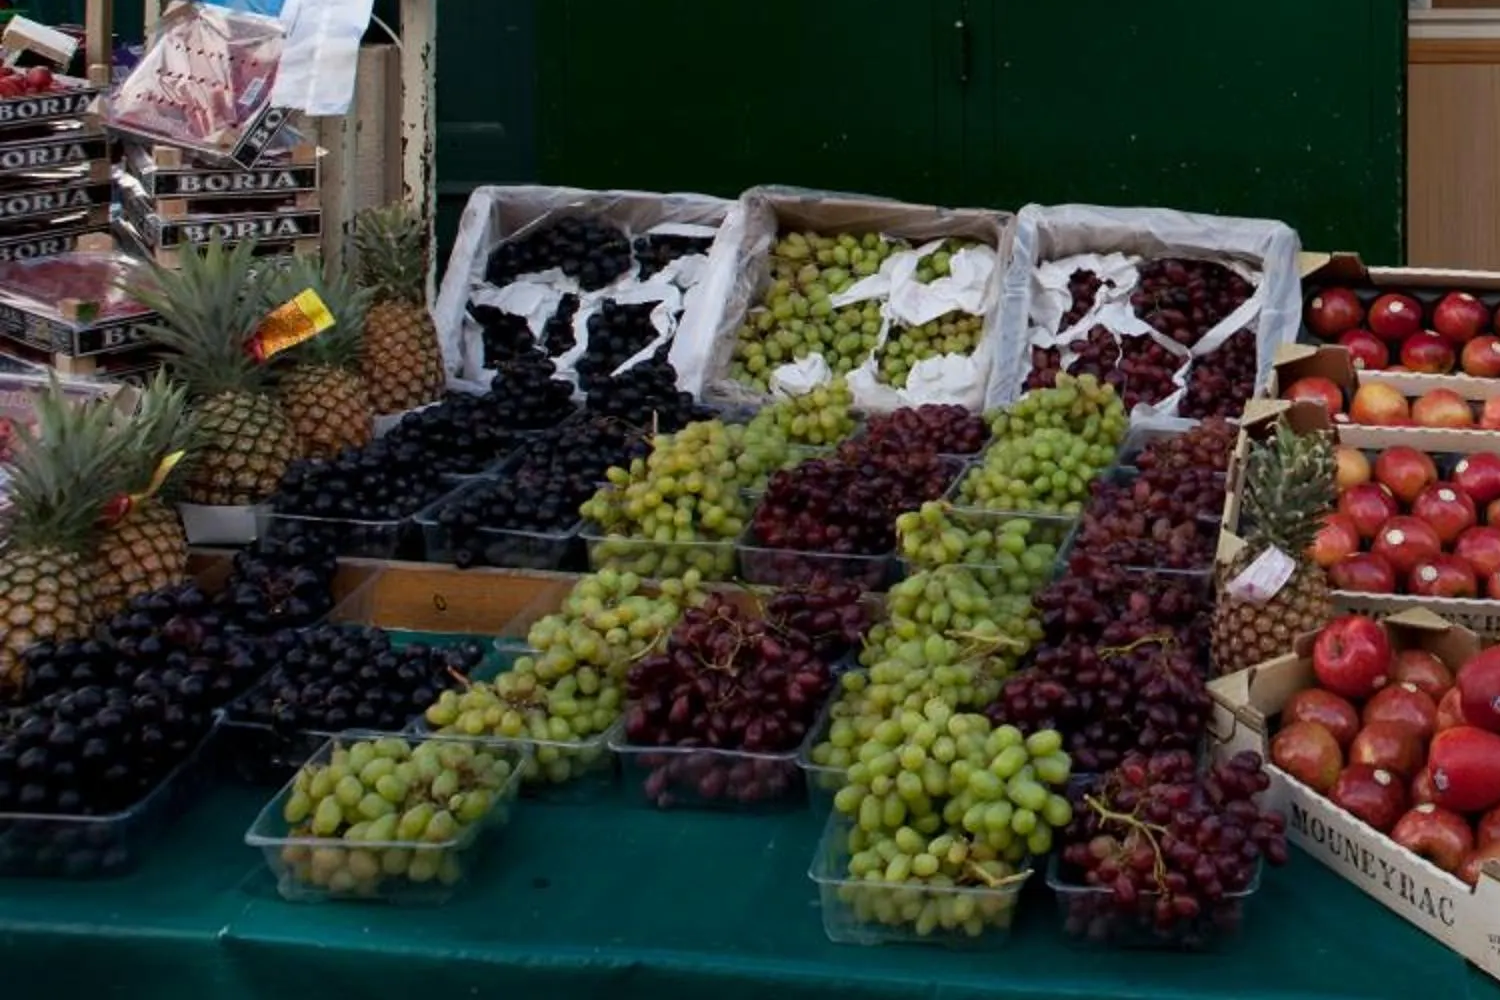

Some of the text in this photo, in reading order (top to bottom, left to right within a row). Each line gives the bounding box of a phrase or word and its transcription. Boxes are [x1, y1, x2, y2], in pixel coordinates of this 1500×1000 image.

[0, 144, 88, 169] ORJA
[180, 171, 296, 191] BORJA
[0, 189, 91, 214] ORJA
[1291, 801, 1455, 927] MOUNEYRAC
